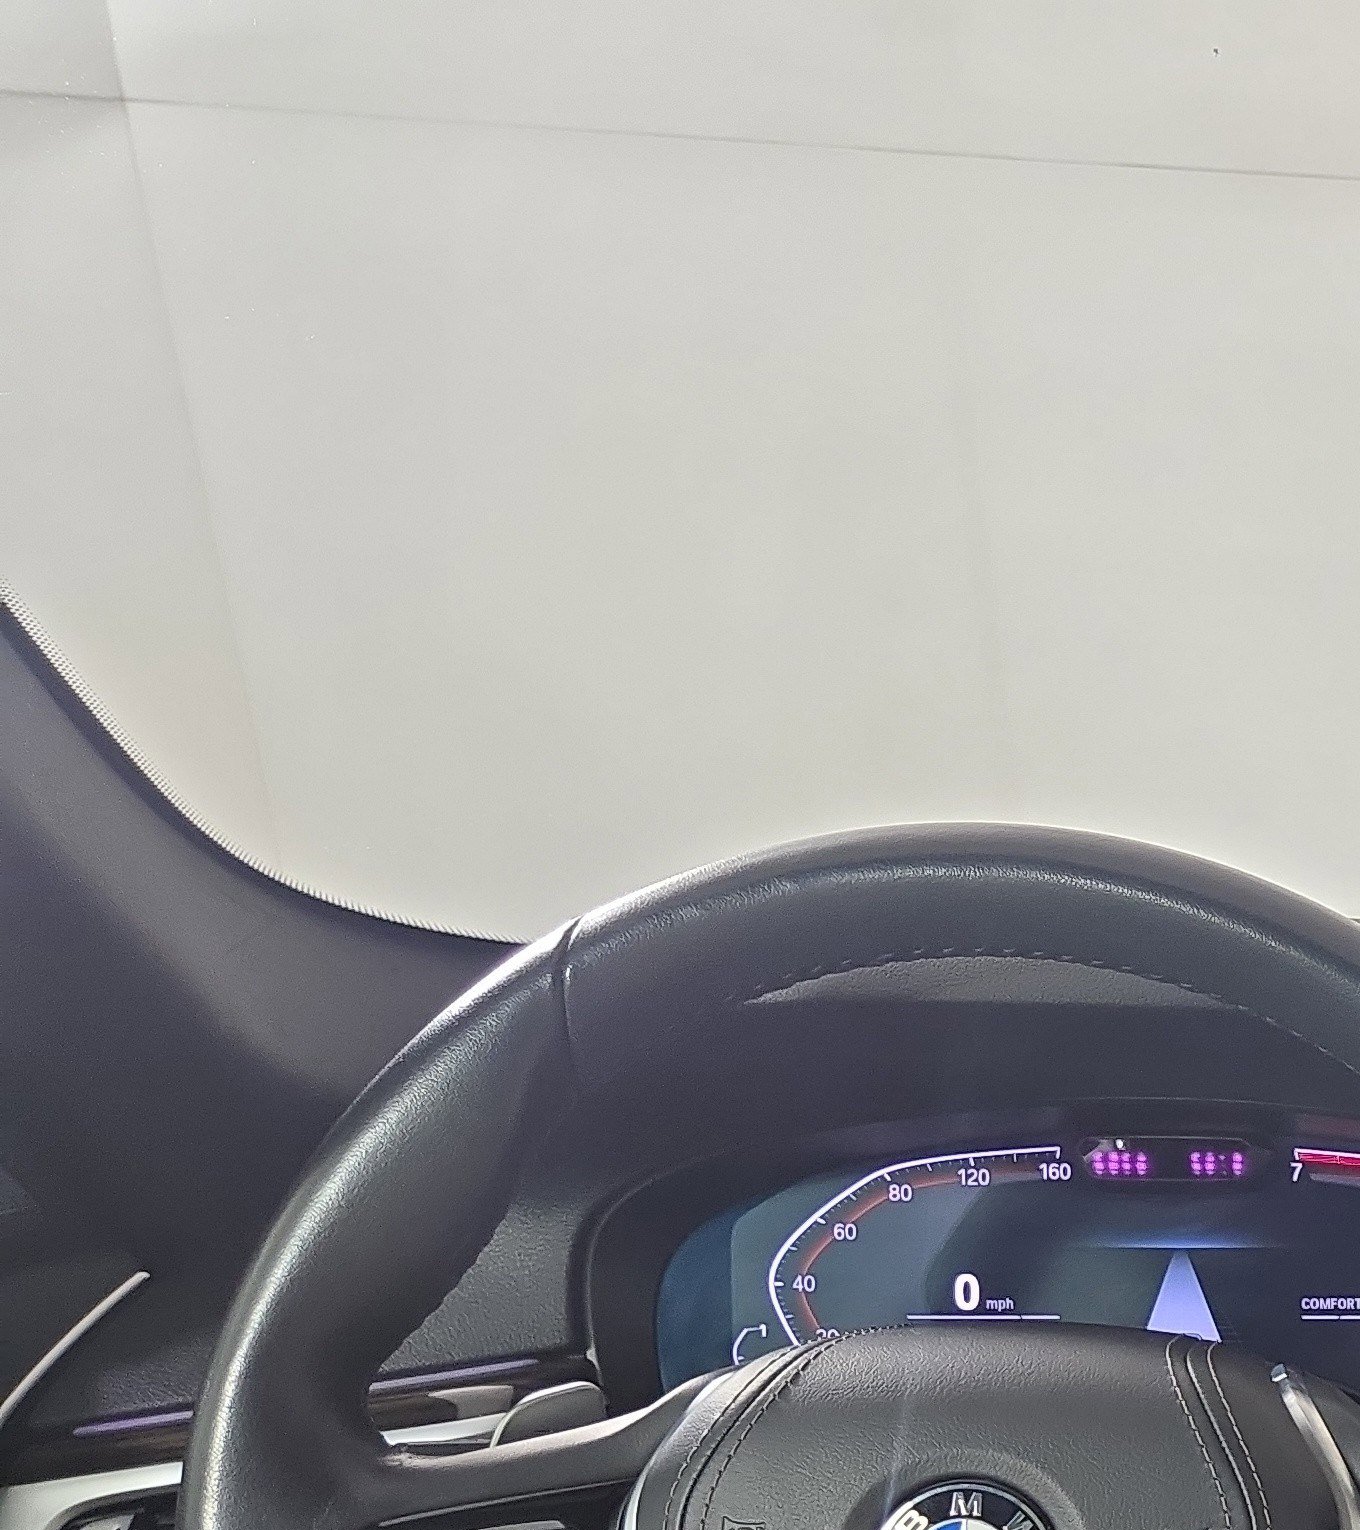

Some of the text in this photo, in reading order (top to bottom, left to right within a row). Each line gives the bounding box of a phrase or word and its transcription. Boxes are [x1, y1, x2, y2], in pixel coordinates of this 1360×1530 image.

[957, 1168, 990, 1187] 120
[1038, 1162, 1072, 1182] 160
[1289, 1162, 1303, 1182] 7
[888, 1184, 913, 1202] 80
[833, 1223, 857, 1242] 60
[792, 1275, 816, 1293] 40
[953, 1273, 1014, 1314] 0 mph
